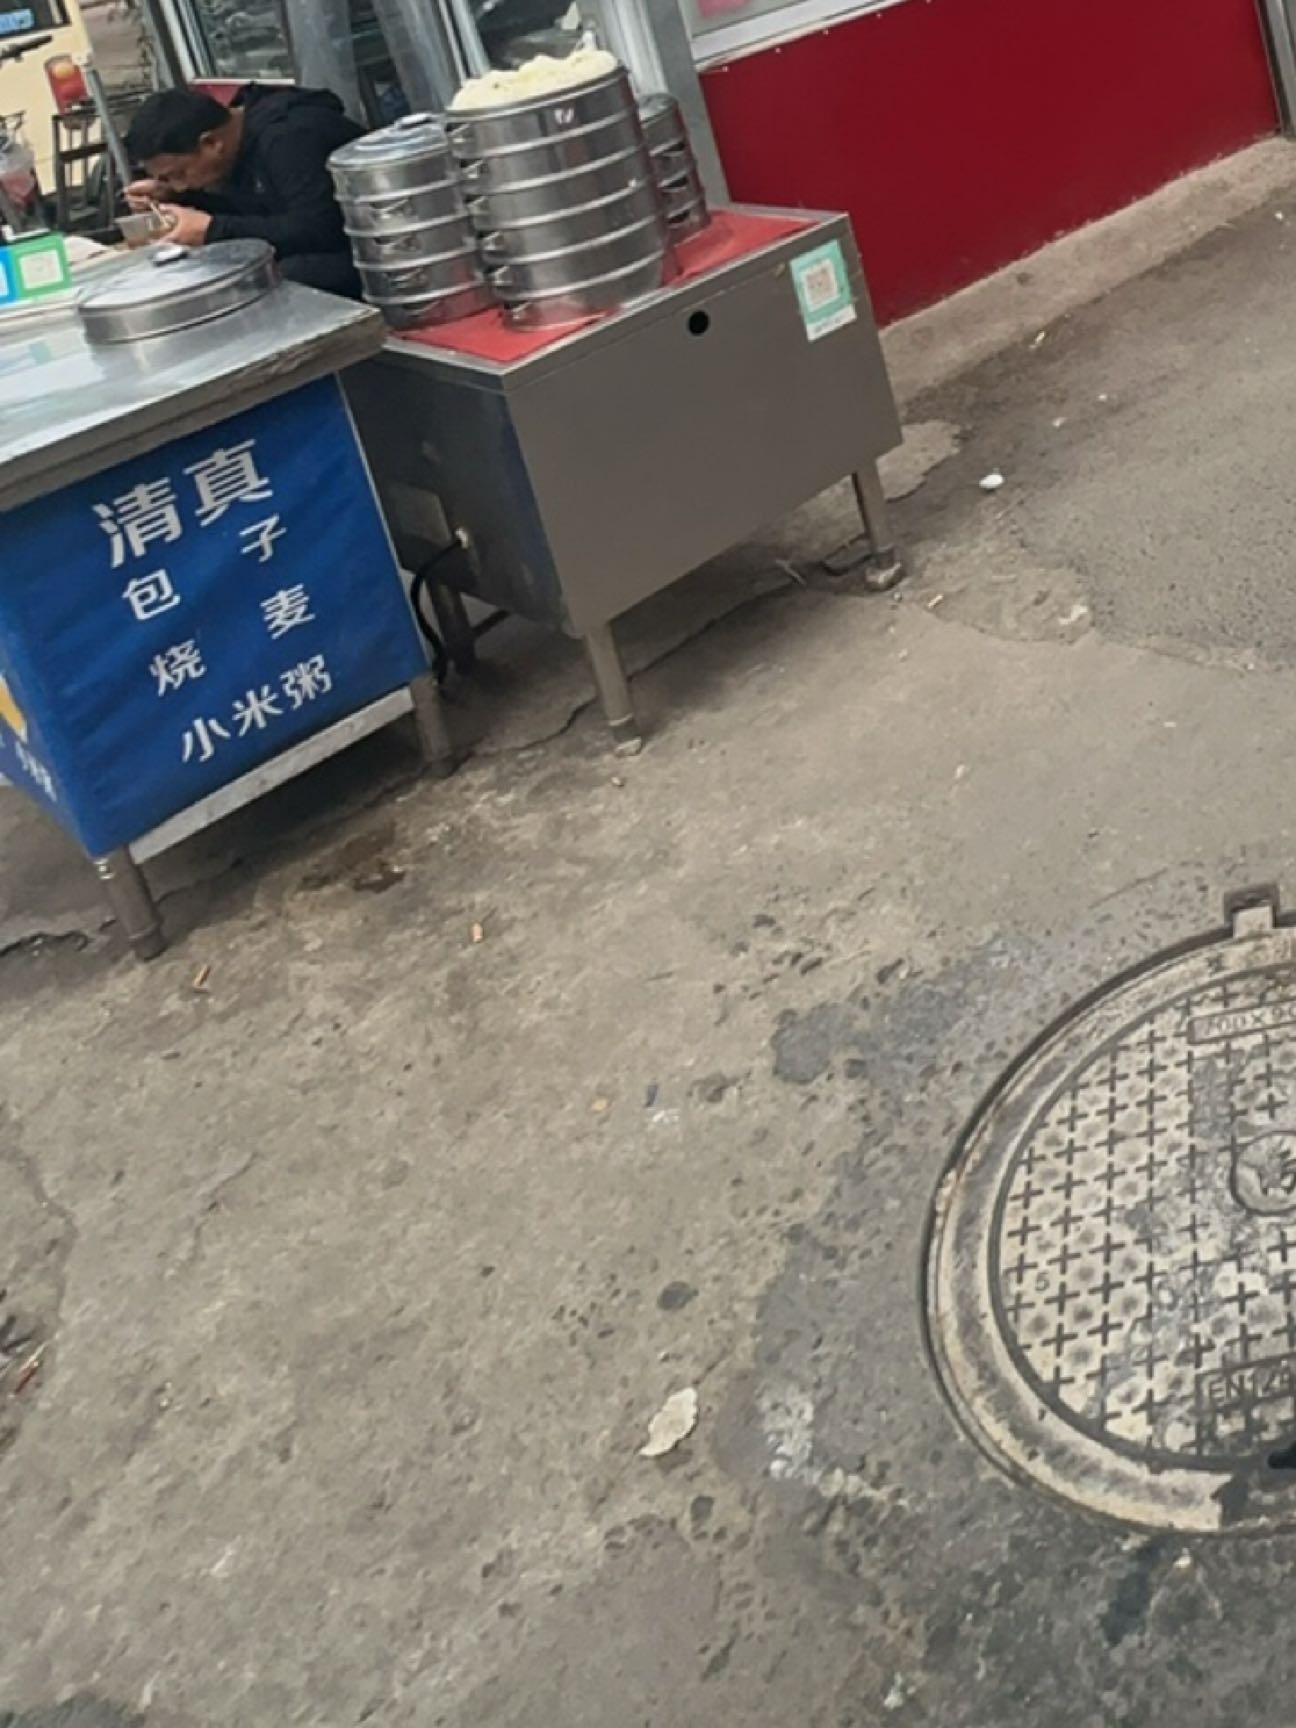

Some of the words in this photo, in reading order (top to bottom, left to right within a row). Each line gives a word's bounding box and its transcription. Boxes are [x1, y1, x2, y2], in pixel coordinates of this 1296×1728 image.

[92, 438, 275, 569] 清真
[121, 512, 288, 622] 包子
[148, 582, 317, 697] 烧麦
[180, 653, 334, 765] 小米粥
